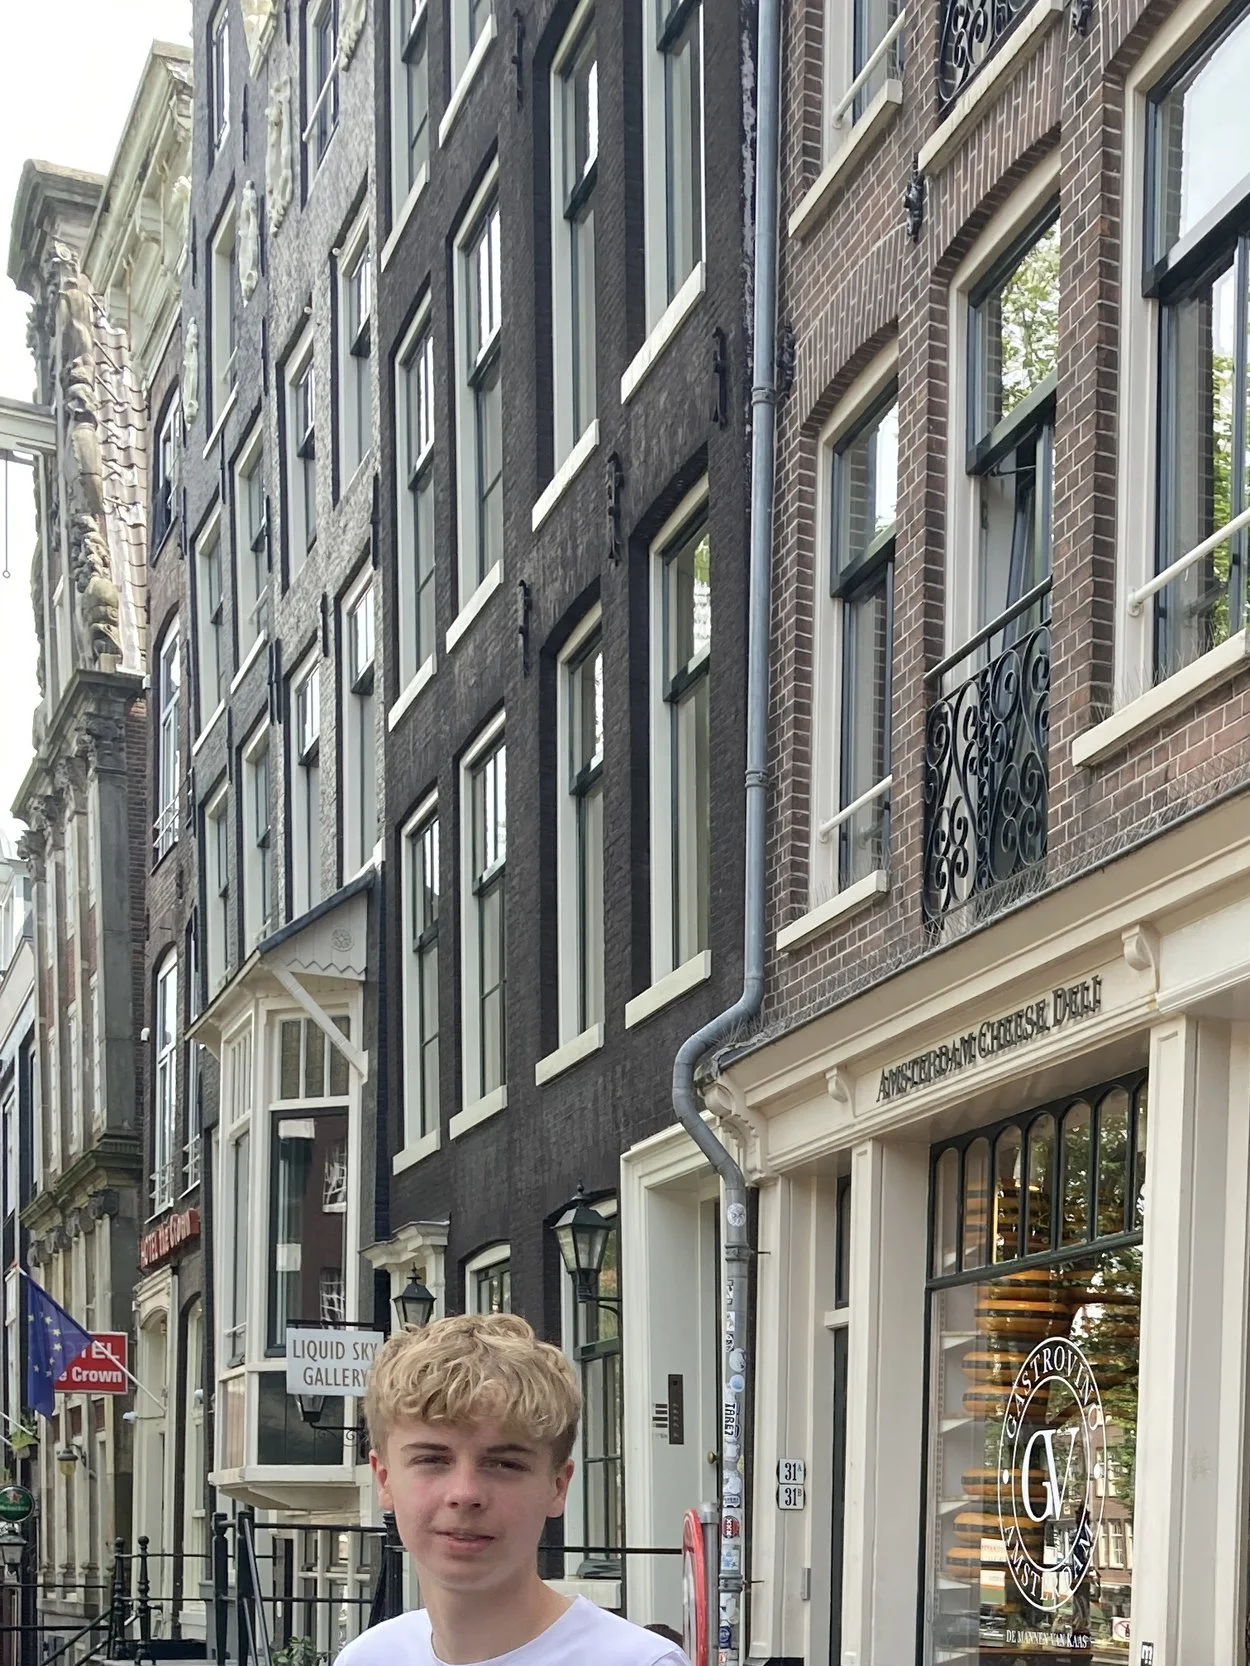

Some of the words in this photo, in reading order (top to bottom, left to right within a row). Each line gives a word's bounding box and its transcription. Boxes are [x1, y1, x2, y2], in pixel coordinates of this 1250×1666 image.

[876, 1031, 977, 1102] AMSTERDAM
[977, 999, 1050, 1058] CHEESE
[1052, 974, 1103, 1027] DELI
[71, 1366, 123, 1383] Crown
[293, 1340, 345, 1362] LIQUID
[352, 1342, 378, 1361] SKY
[303, 1367, 368, 1388] GALLERY
[1006, 1345, 1102, 1439] GASTROVINO
[1021, 1427, 1080, 1523] GV
[1004, 1520, 1094, 1601] AMSTERDAM
[1006, 1630, 1017, 1643] DE
